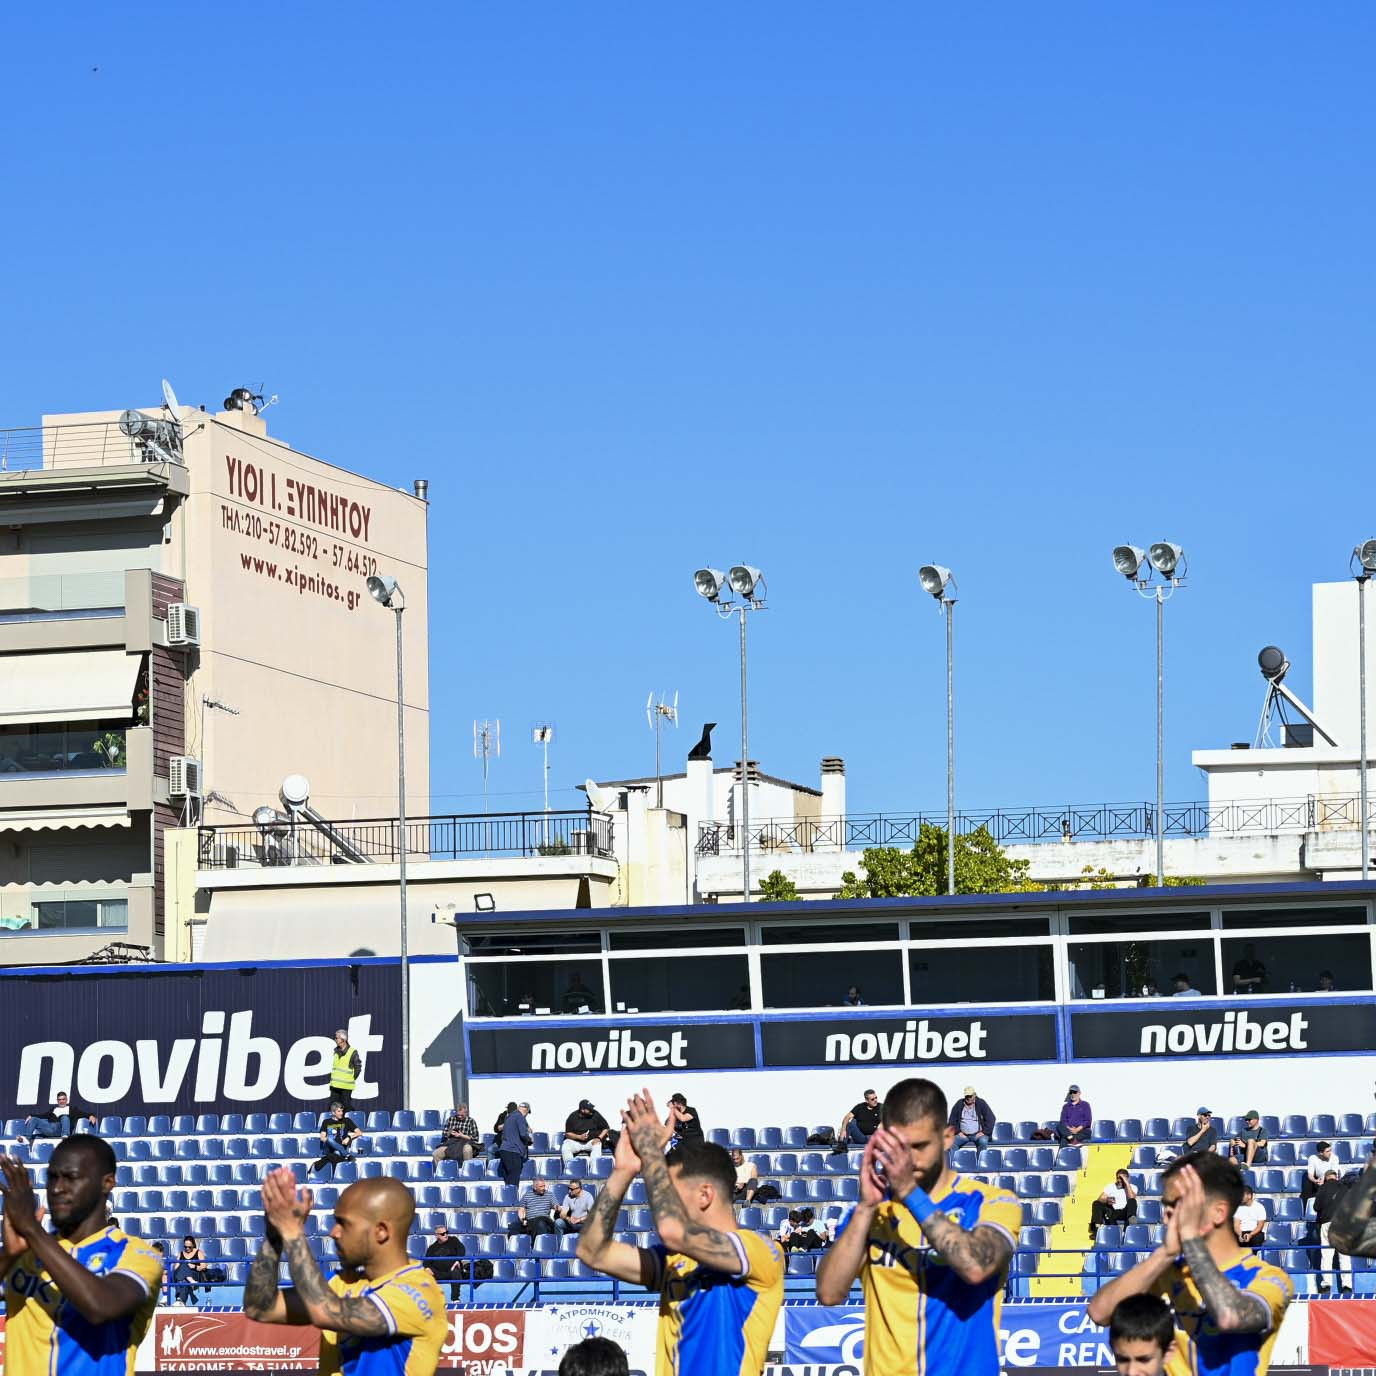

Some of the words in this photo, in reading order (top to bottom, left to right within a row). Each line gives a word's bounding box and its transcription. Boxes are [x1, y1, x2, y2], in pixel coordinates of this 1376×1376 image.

[225, 455, 264, 506] ΥΙΟΙ
[286, 478, 371, 542] ΞΥΠΝΗΤΟΥ
[240, 552, 361, 611] www.xipnitos.gr
[531, 1029, 688, 1070] novibet
[825, 1020, 987, 1063] novibet
[1140, 1010, 1308, 1054] novibet
[16, 1009, 384, 1106] novibet
[441, 1312, 518, 1354] dos
[559, 1308, 625, 1325] ΑΤΡΟΜΗΤΟΣ
[188, 1344, 302, 1359] www.exodostravel.gr
[1058, 1342, 1116, 1367] REN
